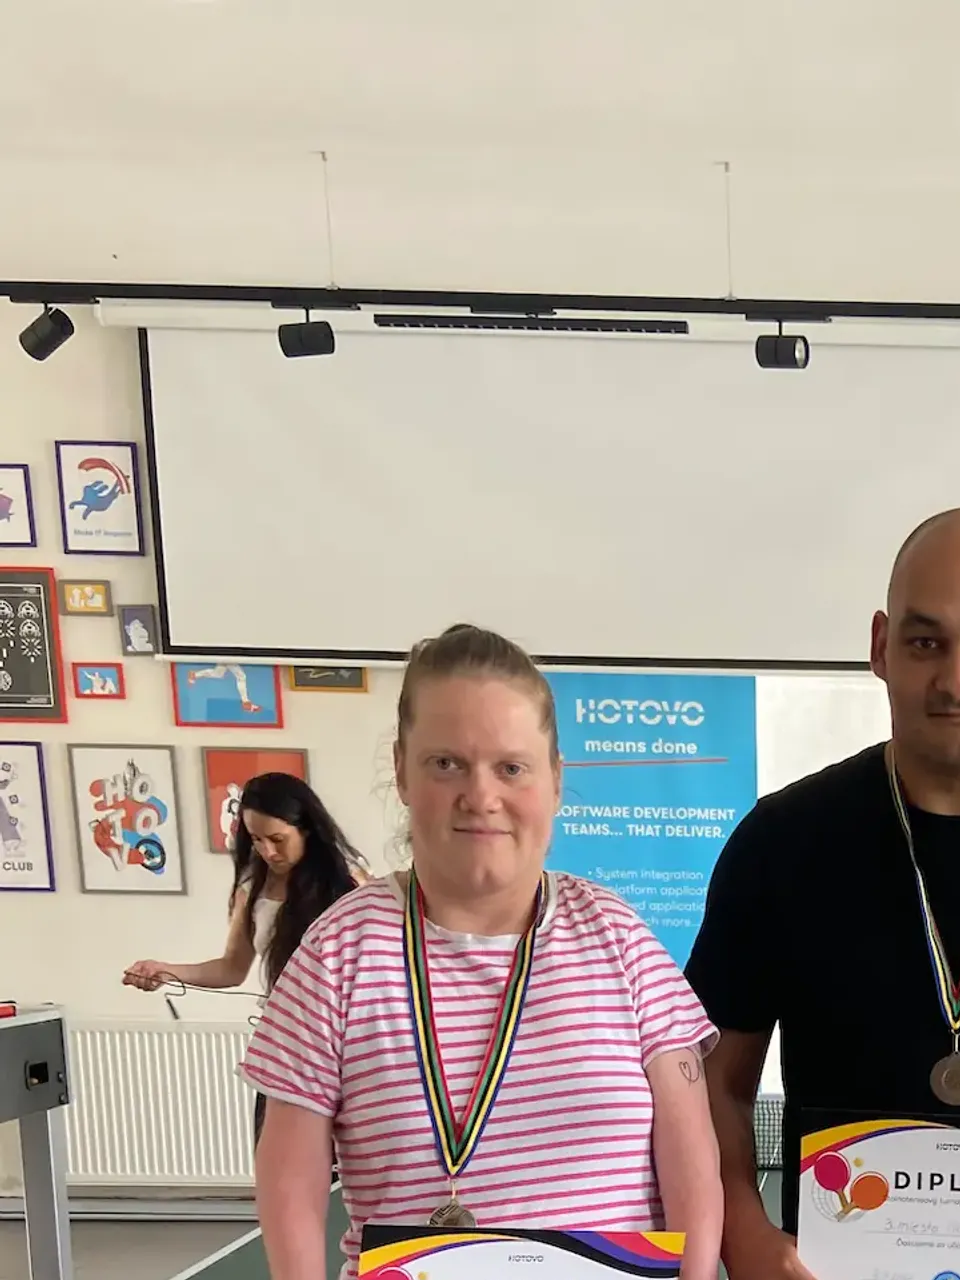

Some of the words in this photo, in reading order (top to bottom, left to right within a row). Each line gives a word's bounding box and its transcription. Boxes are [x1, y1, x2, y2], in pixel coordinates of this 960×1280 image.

[575, 698, 706, 727] HOTOVO
[584, 739, 647, 753] means
[651, 737, 698, 755] done
[634, 806, 736, 821] DEVELOPMENT
[562, 823, 623, 837] TEAMS...
[627, 823, 662, 837] THAT
[666, 824, 726, 839] DELIVER.
[2, 861, 33, 872] CLUB
[595, 867, 638, 881] System
[612, 883, 657, 896] latform
[660, 885, 708, 898] applicat
[649, 900, 707, 913] applicatio
[508, 1254, 544, 1263] HOTOVO
